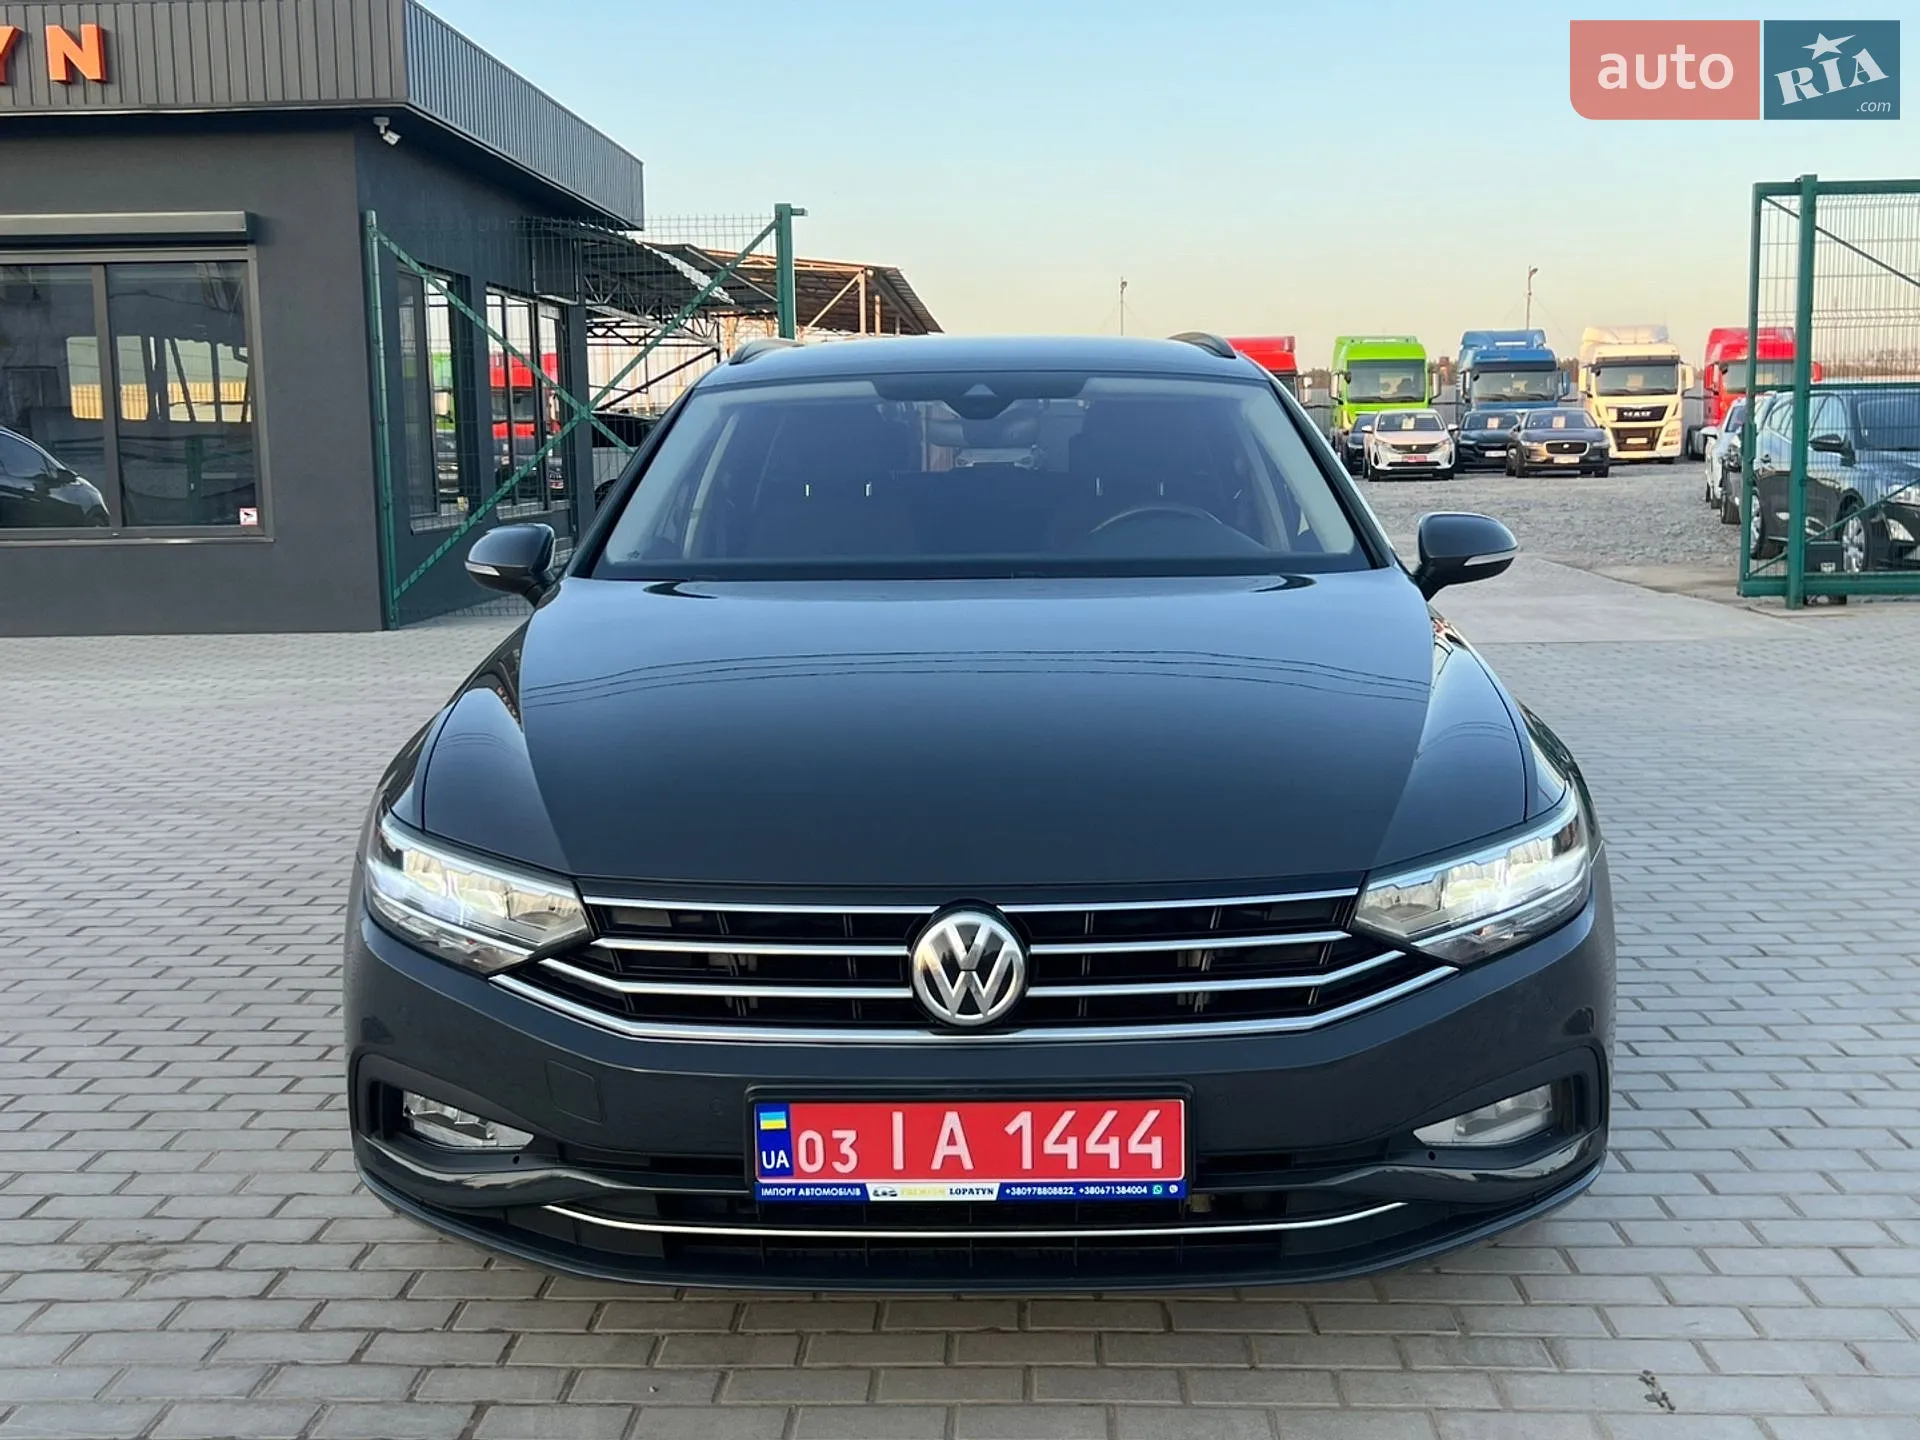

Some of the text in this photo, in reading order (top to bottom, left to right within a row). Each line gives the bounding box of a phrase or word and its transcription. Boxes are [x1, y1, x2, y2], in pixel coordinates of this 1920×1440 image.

[798, 1129, 858, 1174] 03
[1004, 1109, 1163, 1170] 1444
[762, 1149, 790, 1169] UA
[949, 1187, 994, 1196] LOPATYN
